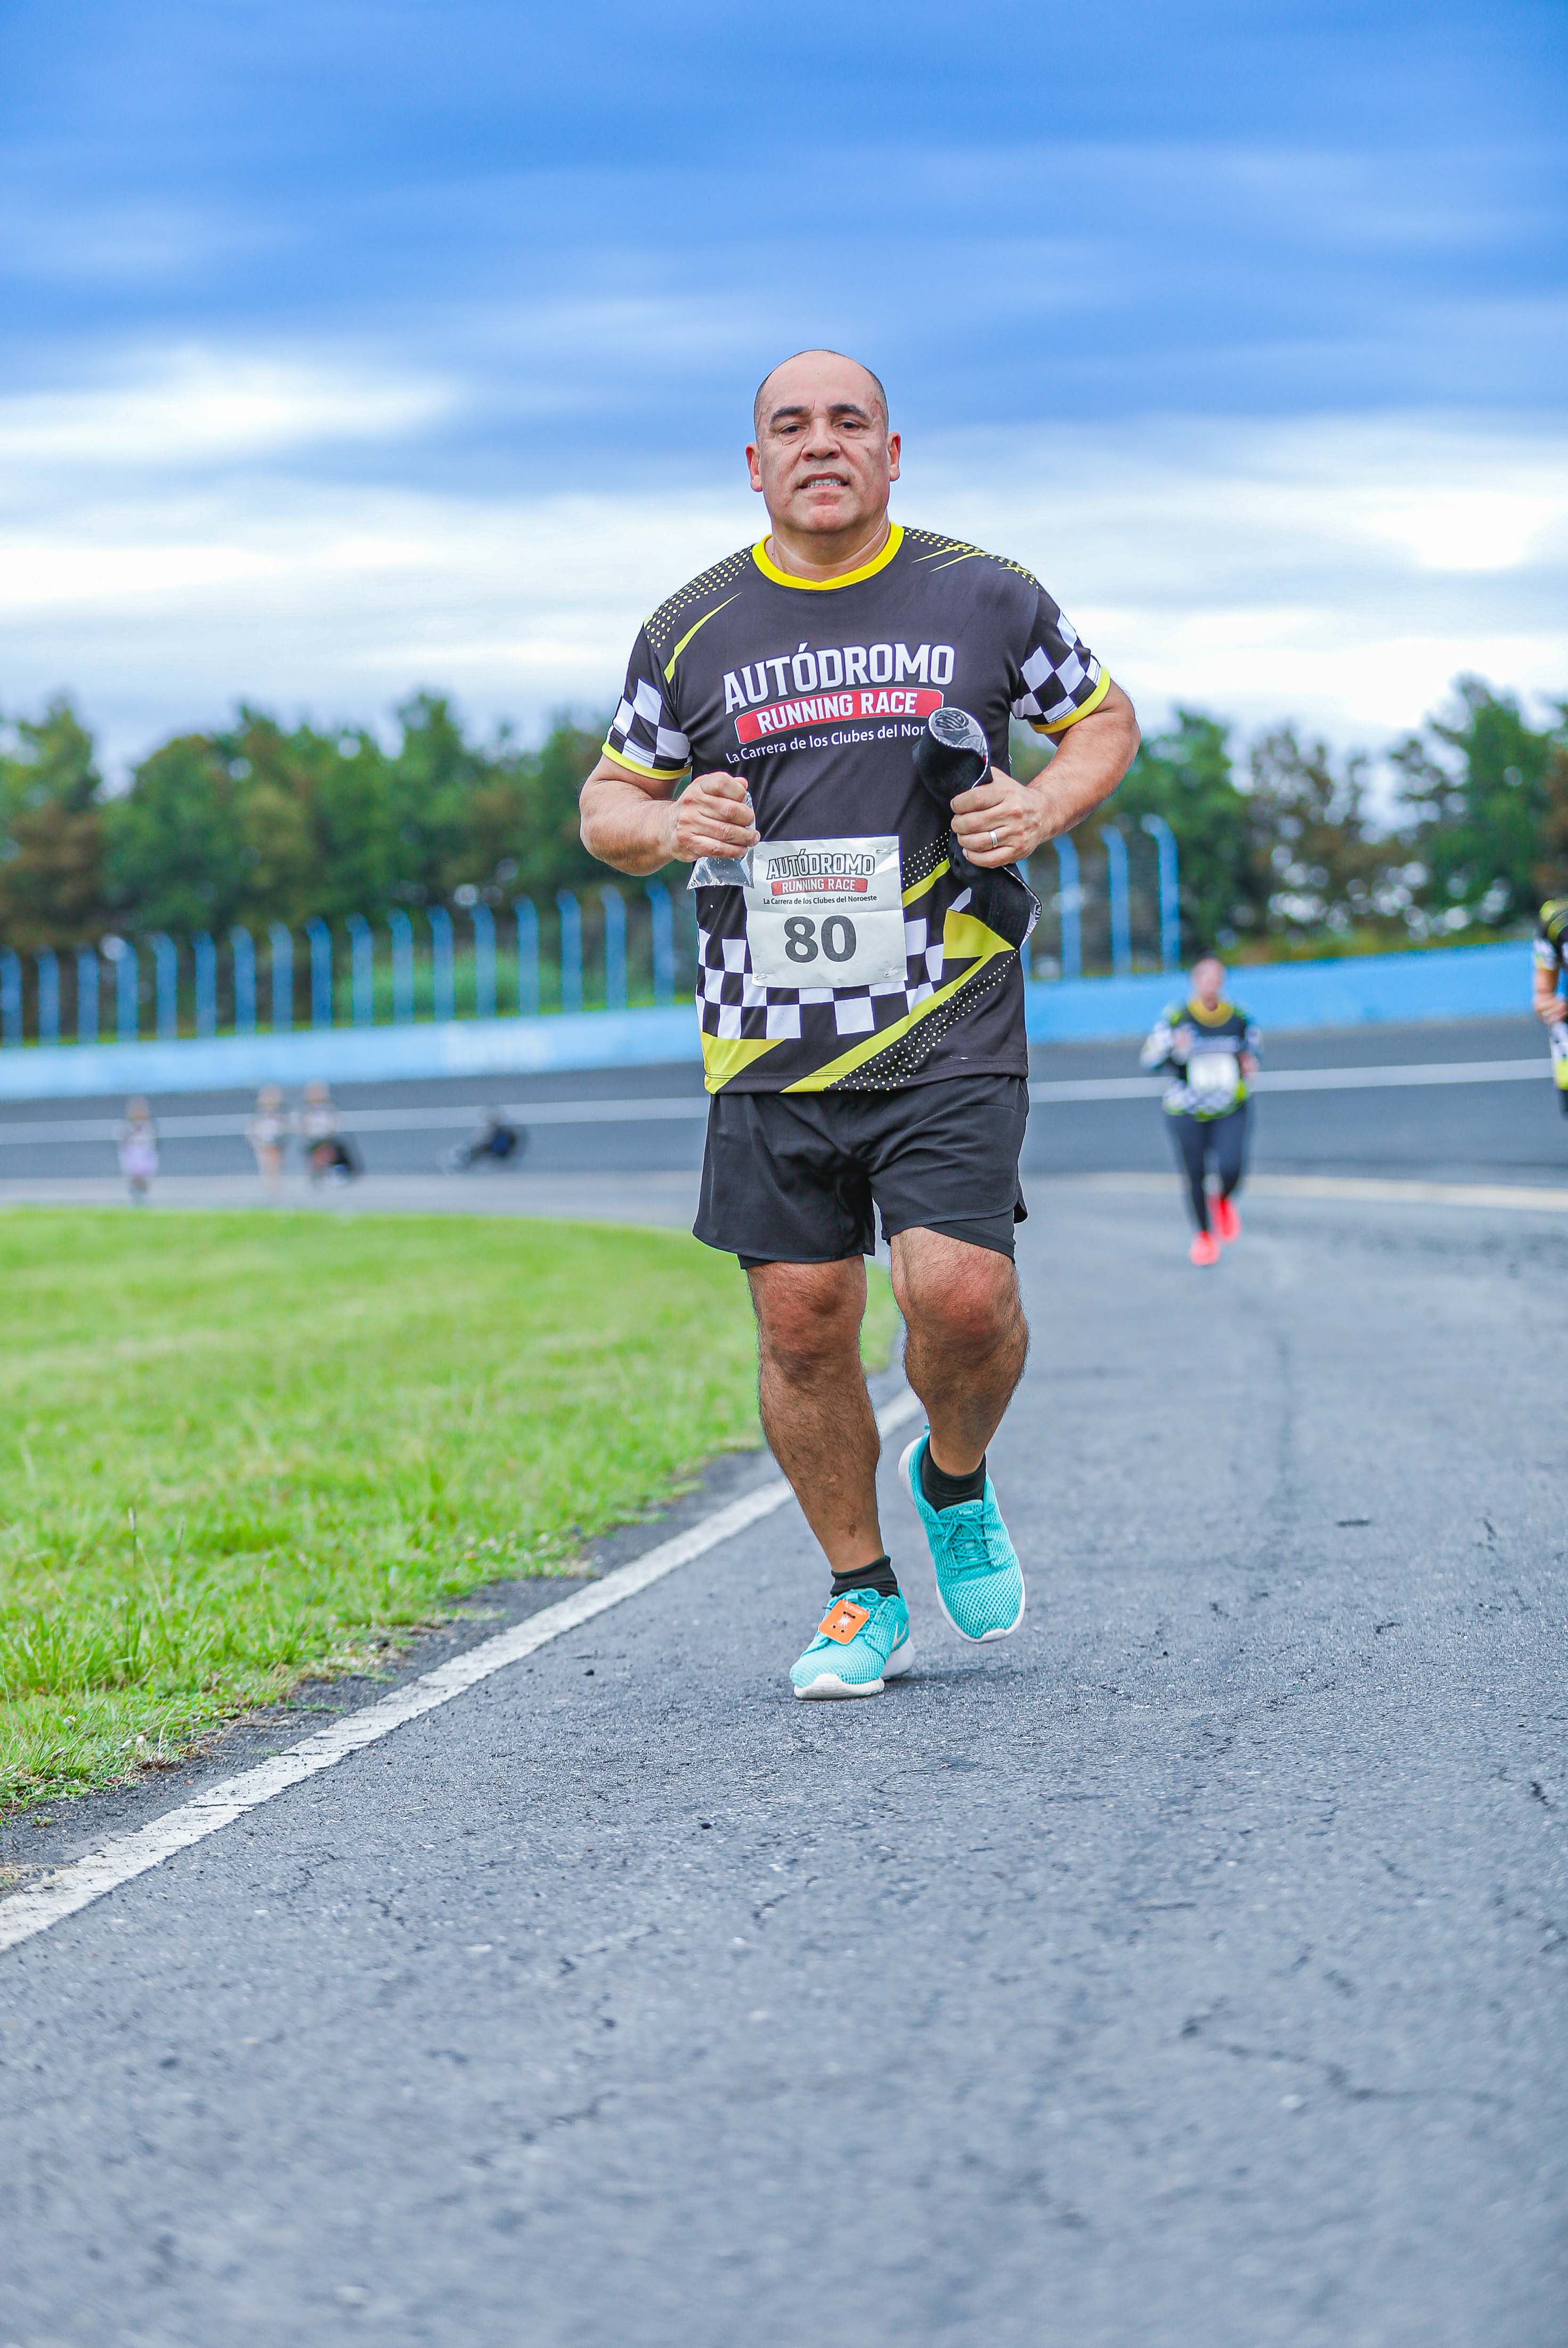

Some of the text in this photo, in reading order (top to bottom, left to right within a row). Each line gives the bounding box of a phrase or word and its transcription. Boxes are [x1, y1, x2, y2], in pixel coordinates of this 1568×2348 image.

[722, 642, 956, 715] AUTÓDROMO
[756, 692, 917, 734] RUNNING RACE
[726, 752, 740, 764] La
[741, 741, 786, 760] Carrera
[790, 738, 806, 750] de
[810, 735, 828, 748] los
[831, 729, 874, 745] Clubes
[878, 724, 898, 738] del
[766, 848, 875, 880] AUTÓDROMO
[781, 878, 856, 893] RUNNING RACE
[784, 915, 857, 963] 80
